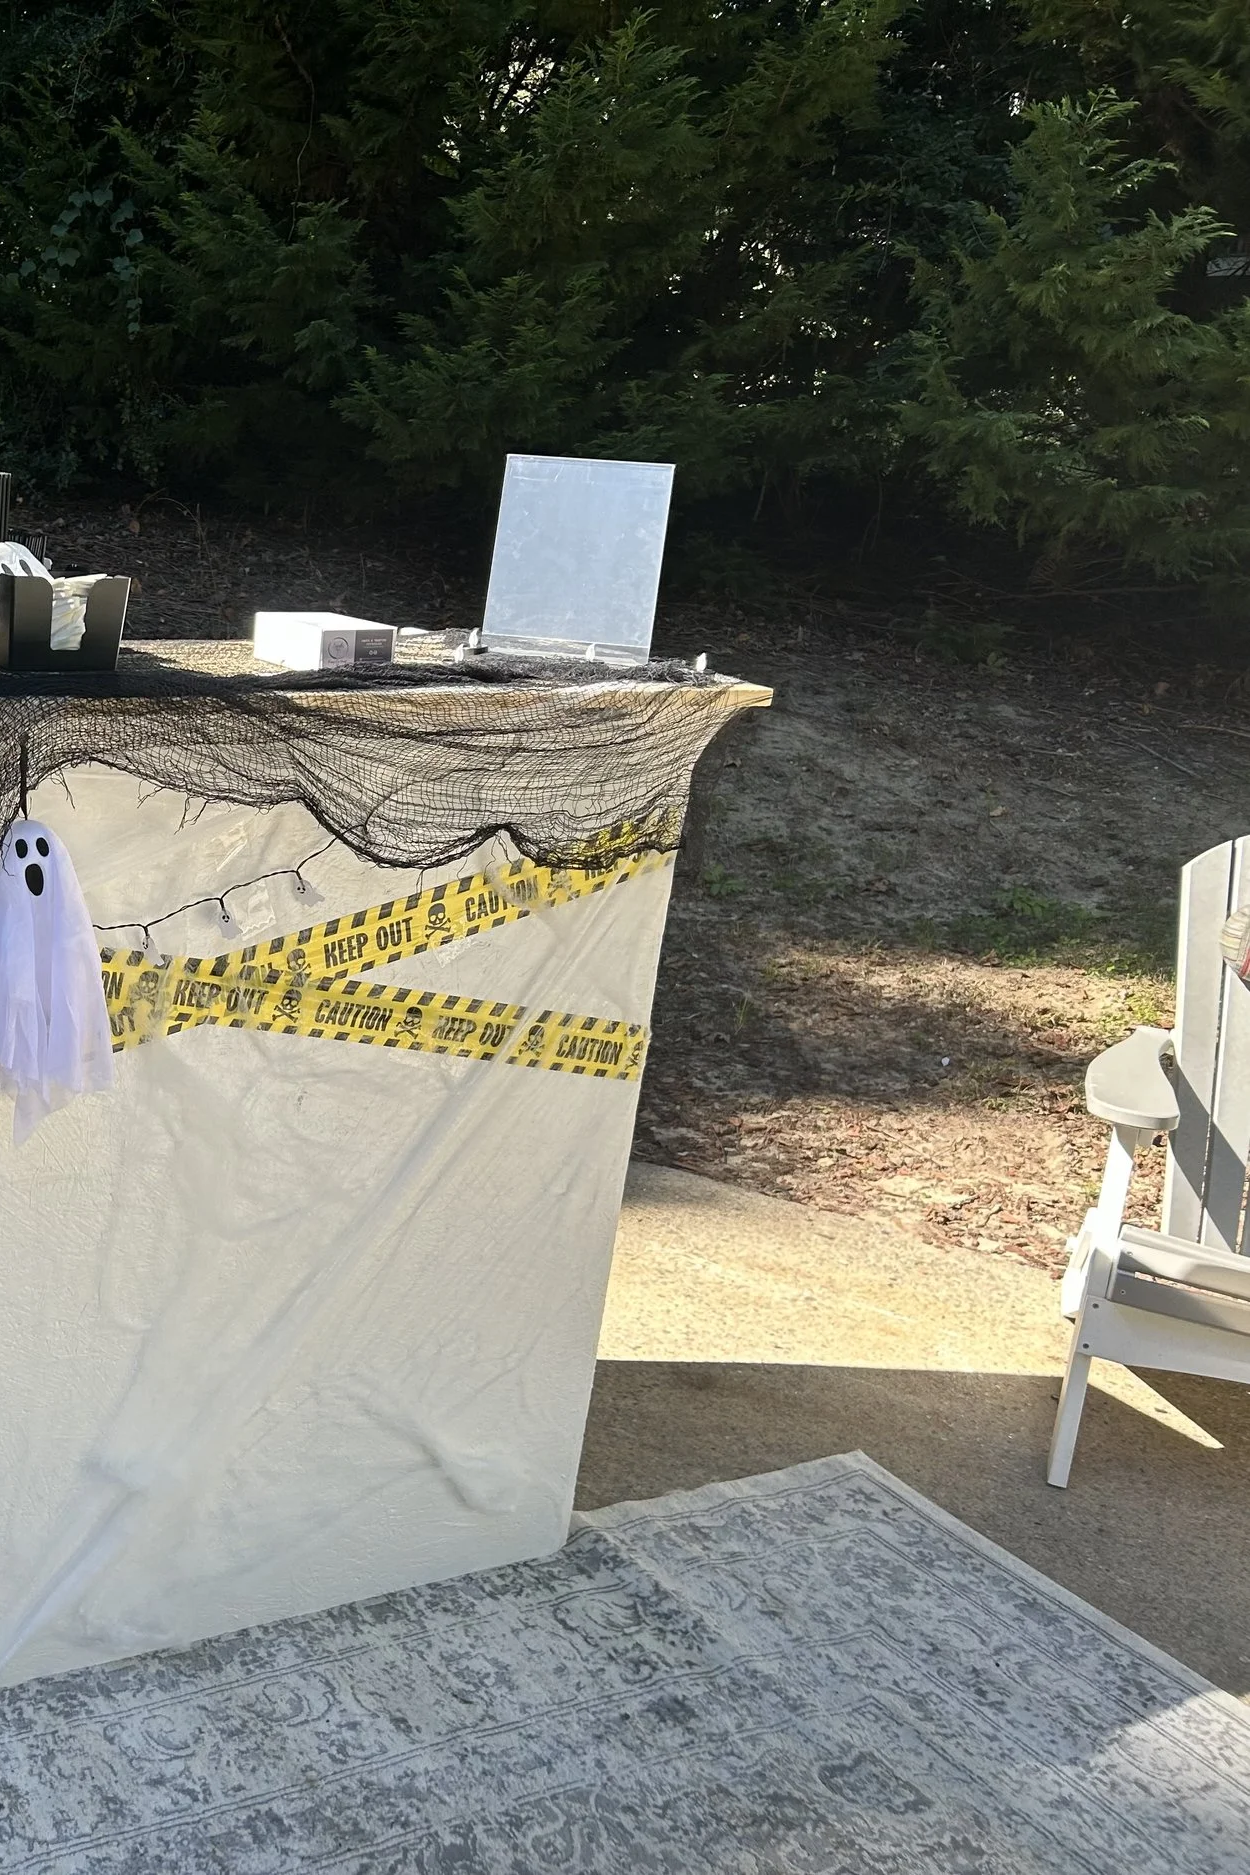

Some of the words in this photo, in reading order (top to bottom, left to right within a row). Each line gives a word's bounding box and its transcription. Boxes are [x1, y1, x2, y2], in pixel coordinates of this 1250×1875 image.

[323, 929, 369, 969] KEEP
[376, 916, 416, 952] OUT
[173, 979, 222, 1009] KEEP
[225, 985, 269, 1015] OUT
[314, 999, 394, 1032] CAUTION
[432, 1015, 478, 1043] KEEP
[479, 1020, 516, 1048] OUT
[555, 1034, 624, 1066] CAUTION
